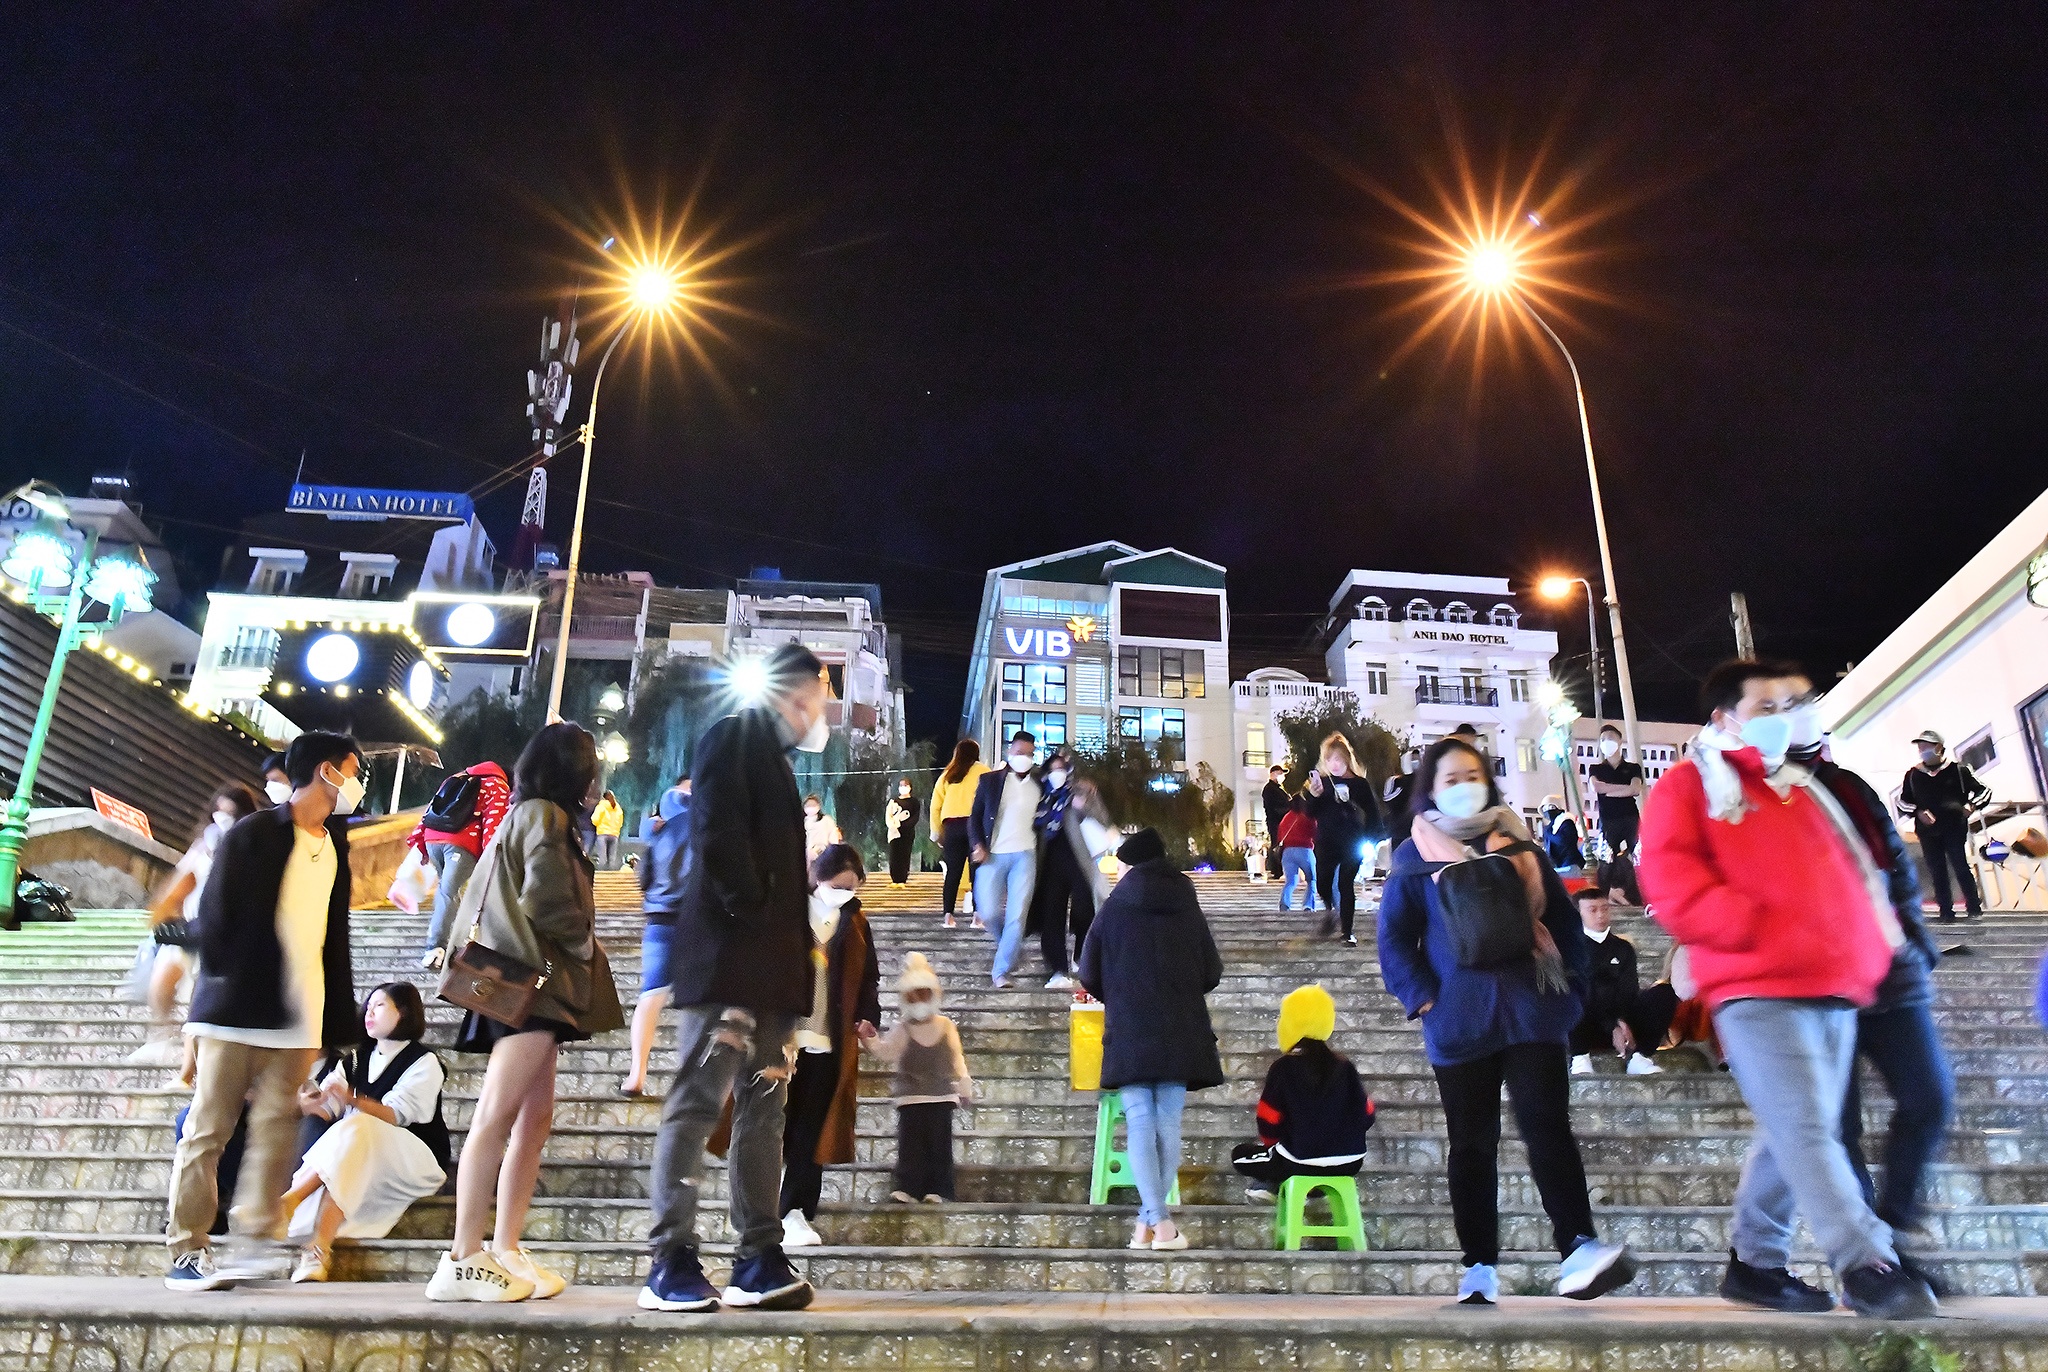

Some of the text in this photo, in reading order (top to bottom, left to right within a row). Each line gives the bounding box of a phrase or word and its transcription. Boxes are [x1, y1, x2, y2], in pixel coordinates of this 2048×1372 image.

[292, 486, 347, 509] BÌNH
[384, 495, 460, 514] HOTEL
[1005, 627, 1071, 657] VIB
[1413, 630, 1438, 640] ANH
[1469, 633, 1509, 645] HOTEL
[455, 1266, 512, 1290] BOSTON
